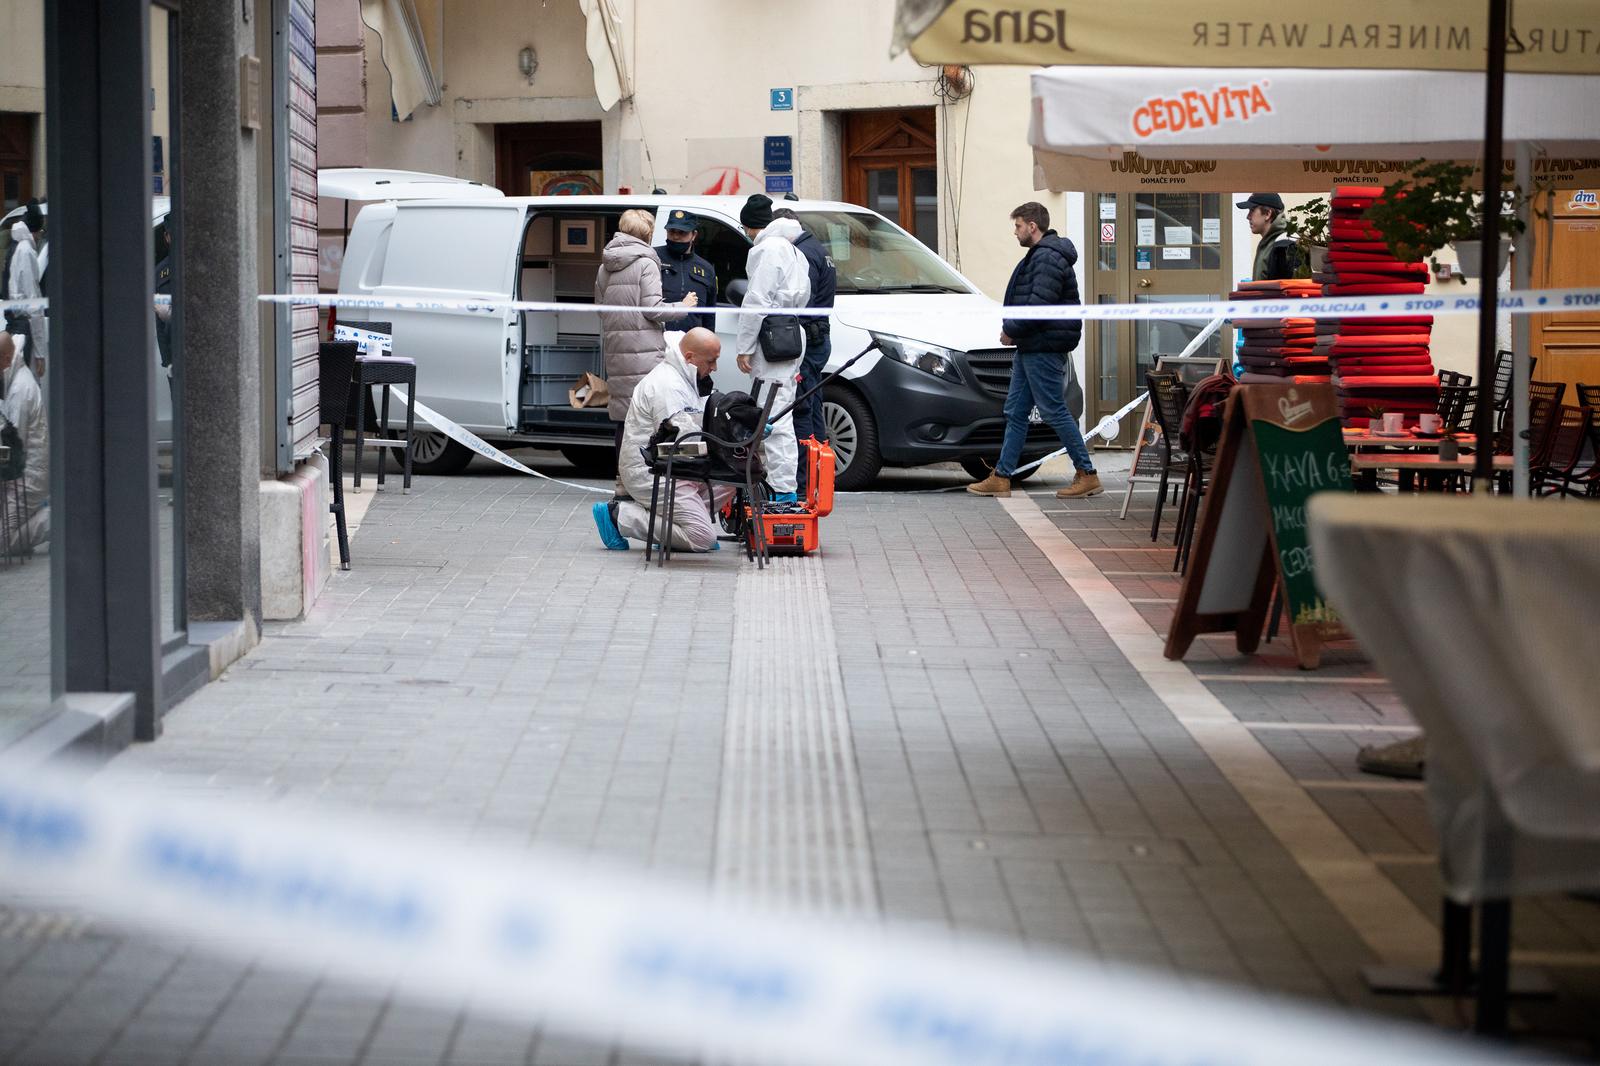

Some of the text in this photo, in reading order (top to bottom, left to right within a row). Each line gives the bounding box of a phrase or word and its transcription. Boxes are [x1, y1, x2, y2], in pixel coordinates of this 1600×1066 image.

[778, 91, 786, 103] 3
[1132, 84, 1272, 137] CEDEVITA
[1574, 190, 1595, 203] dm
[1251, 302, 1367, 314] STOP POLICIJA
[1404, 297, 1524, 311] STOP POIJA
[1150, 307, 1214, 315] POLICIJA
